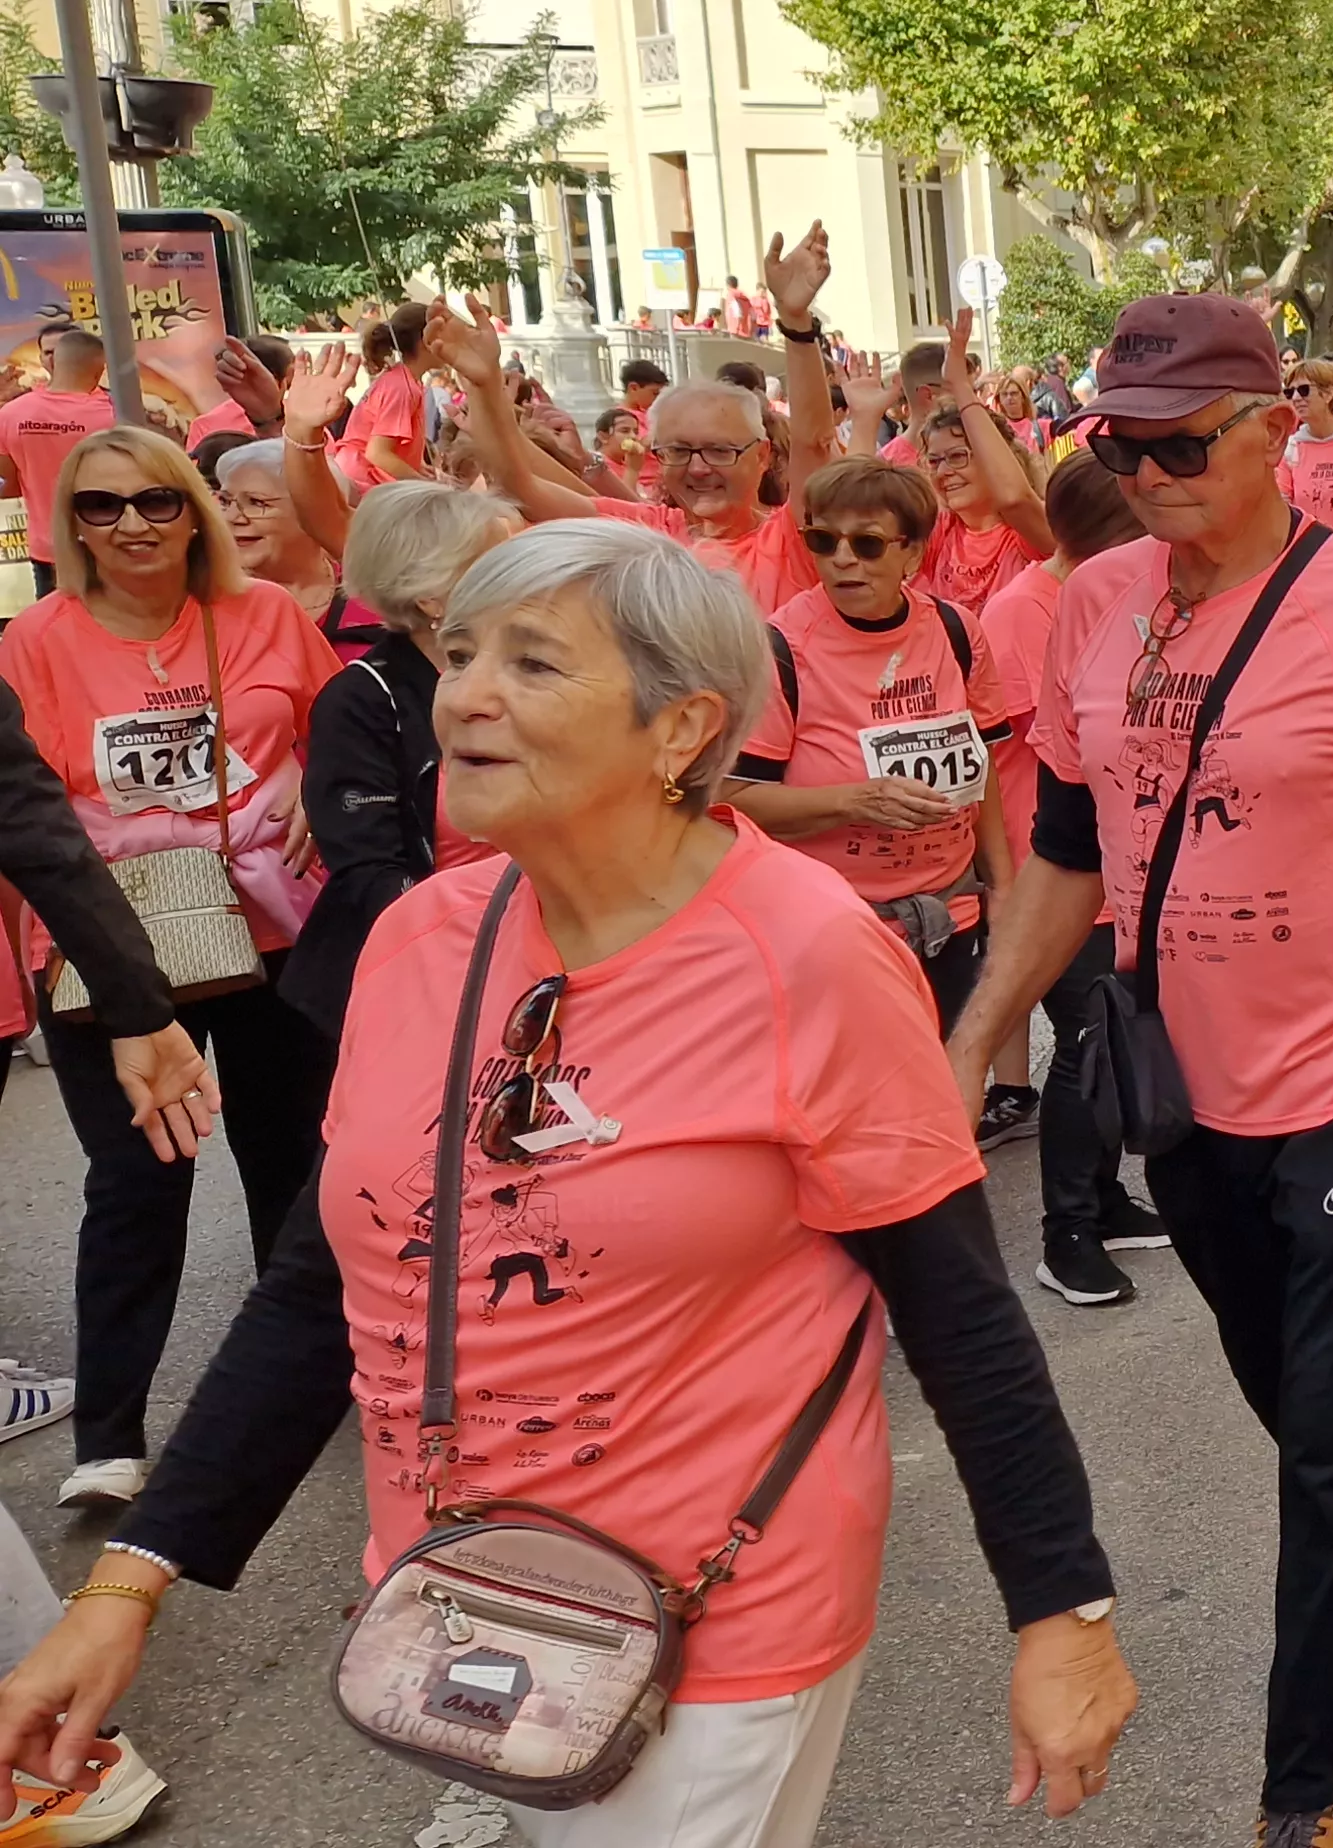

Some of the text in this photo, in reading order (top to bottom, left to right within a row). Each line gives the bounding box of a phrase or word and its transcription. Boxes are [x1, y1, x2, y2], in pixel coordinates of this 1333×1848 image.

[43, 214, 86, 225] URBA
[871, 700, 890, 720] POR
[892, 698, 904, 717] LA
[1122, 701, 1149, 728] POR
[1150, 701, 1167, 728] LA
[114, 733, 170, 746] CONTRA
[917, 730, 948, 741] HUESCA
[881, 740, 930, 755] CONTRA
[930, 738, 944, 749] EL
[1137, 780, 1148, 793] 19
[460, 1412, 507, 1428] URBAN
